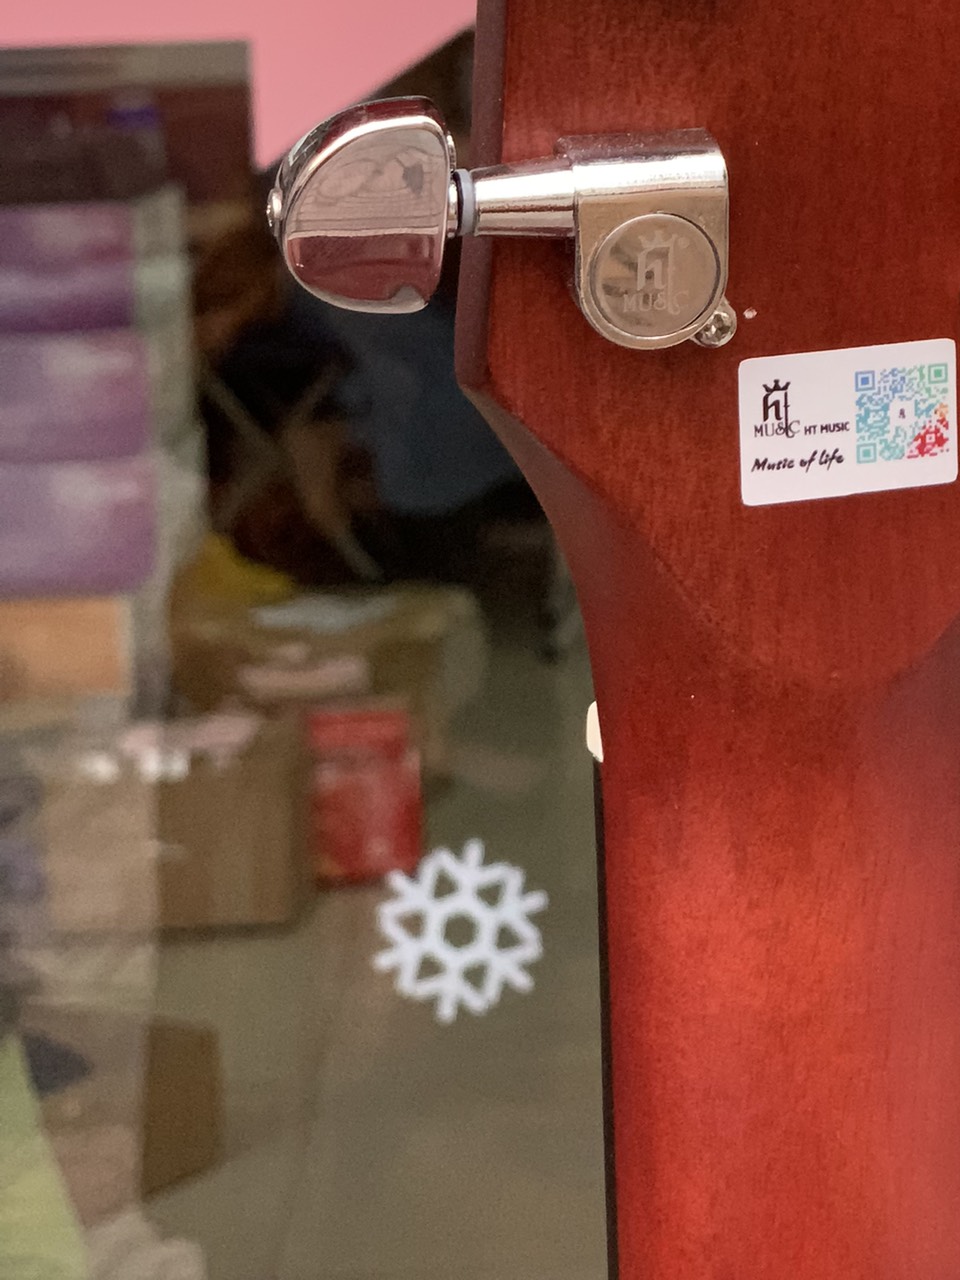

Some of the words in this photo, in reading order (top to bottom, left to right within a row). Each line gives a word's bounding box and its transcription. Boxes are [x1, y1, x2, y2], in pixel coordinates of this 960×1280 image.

[804, 425, 817, 436] HT
[820, 421, 850, 434] MUSIC
[751, 457, 795, 473] Music
[800, 449, 818, 473] of
